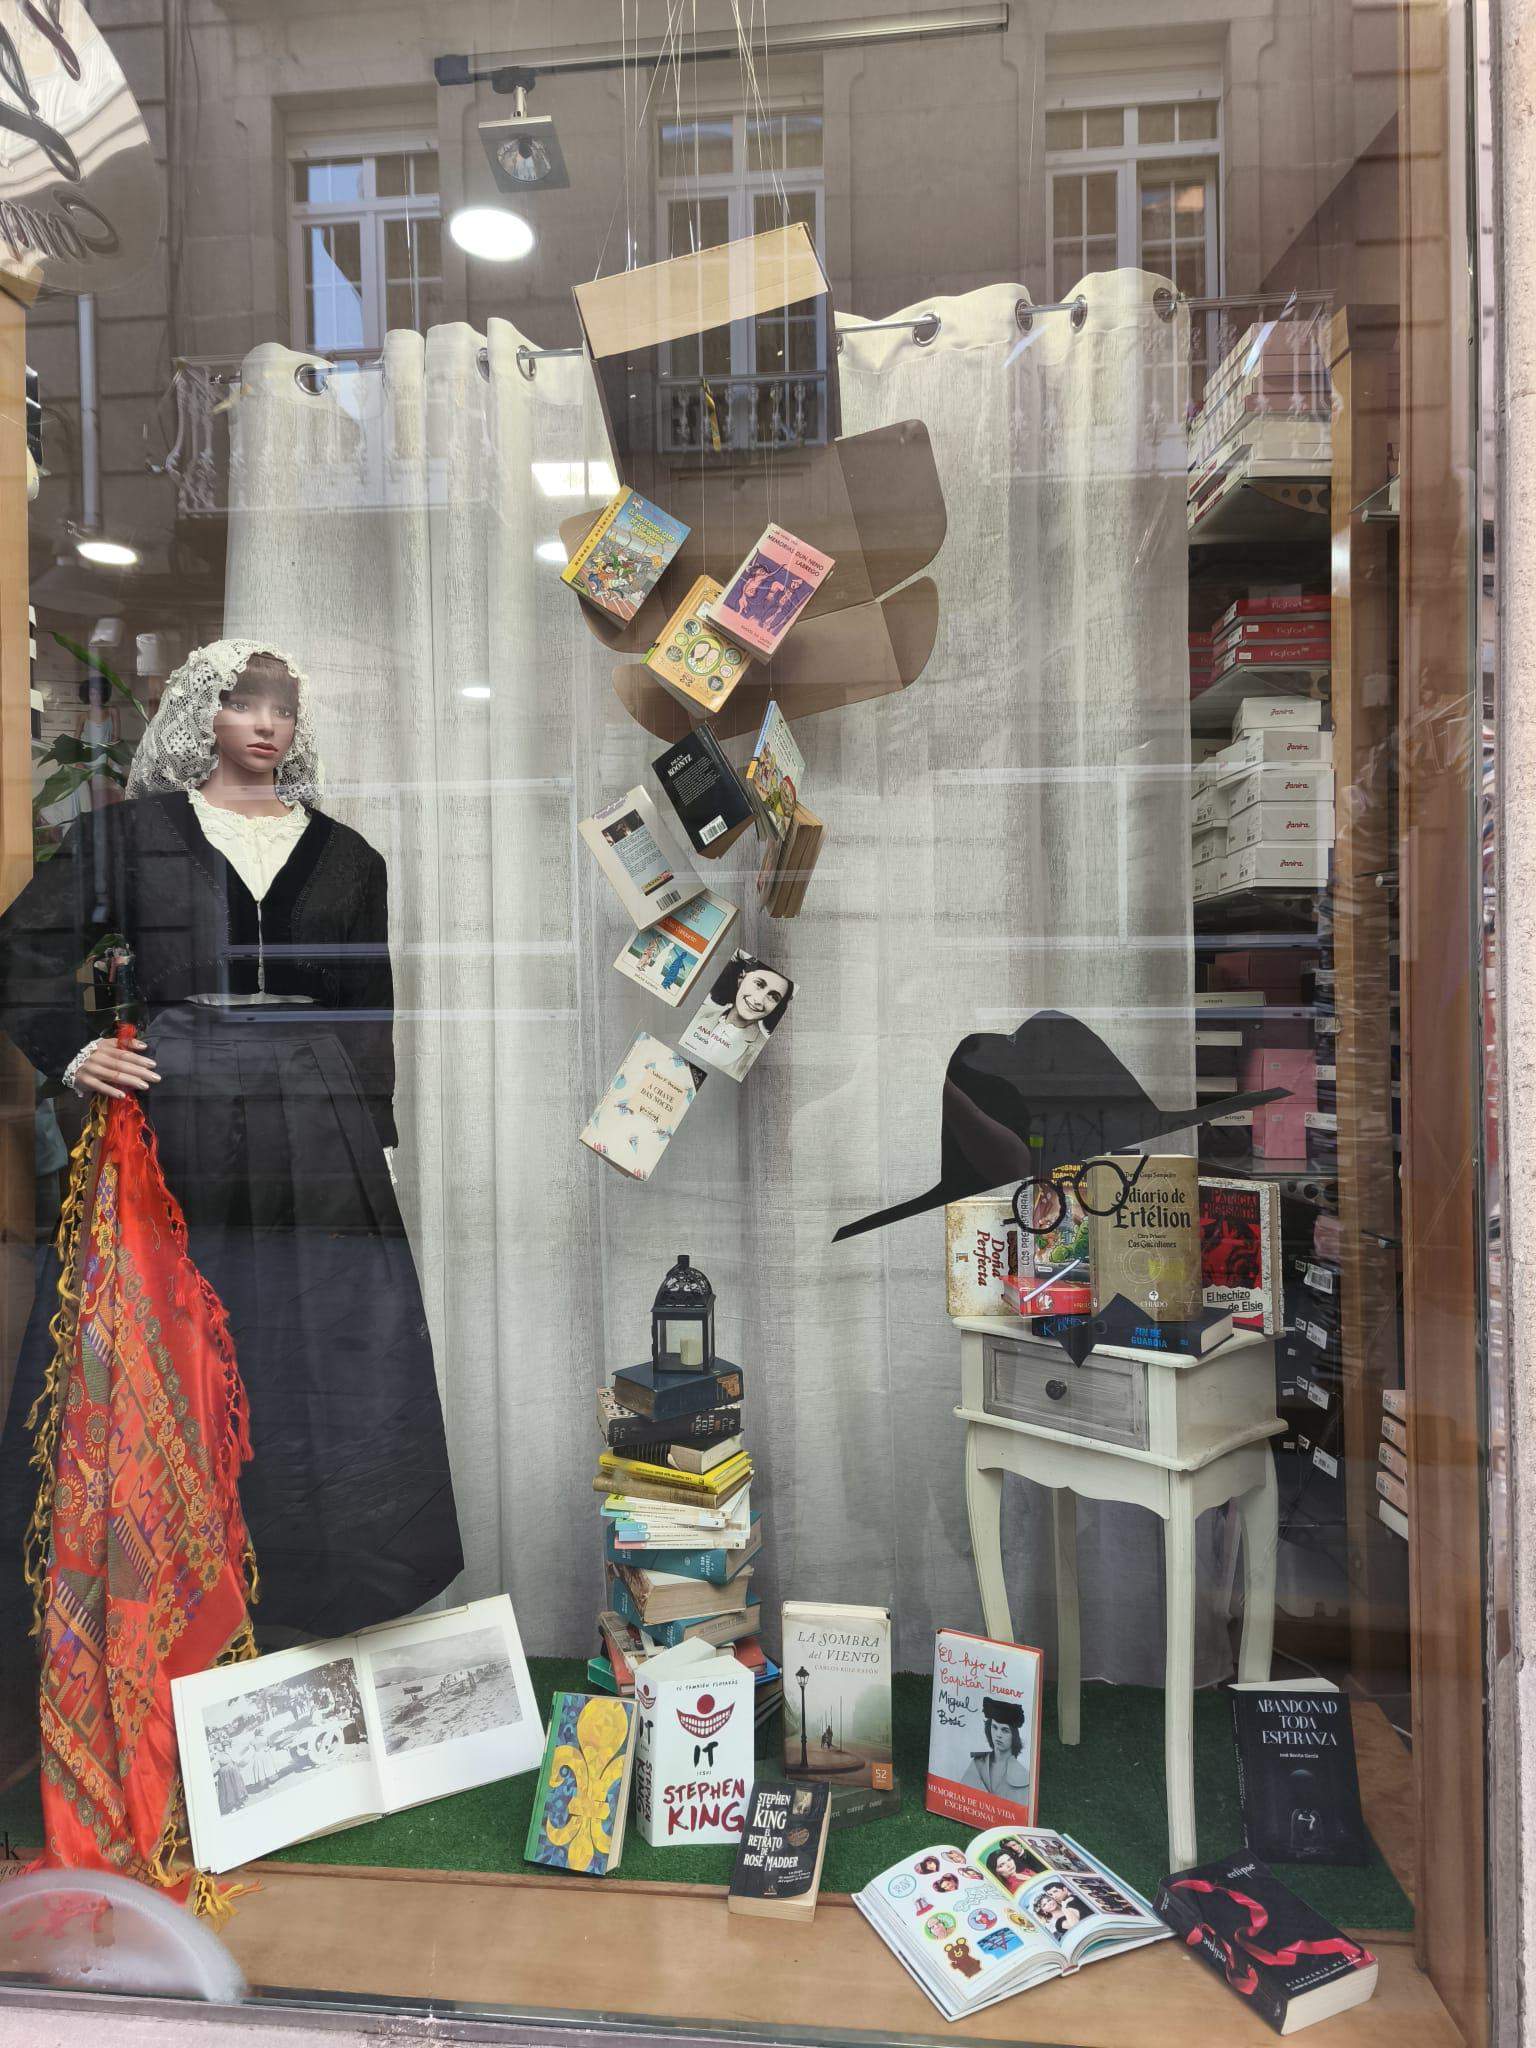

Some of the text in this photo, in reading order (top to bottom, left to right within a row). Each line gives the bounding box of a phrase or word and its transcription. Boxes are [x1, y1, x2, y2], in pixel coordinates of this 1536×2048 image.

[667, 753, 693, 777] KOONTZ
[696, 1024, 712, 1037] ANA
[710, 1031, 731, 1050] FRANK
[1129, 1188, 1169, 1204] diario
[1171, 1188, 1186, 1204] de
[1113, 1203, 1192, 1229] Ertélion
[976, 1229, 991, 1288] Perfecta
[991, 1238, 1006, 1279] Doña
[1206, 1289, 1251, 1301] El hechizo
[1227, 1301, 1263, 1312] de Elsie
[797, 1631, 880, 1648] LA SOMBRA
[808, 1649, 880, 1664] del VIENTO
[938, 1643, 1008, 1678] El hijo del
[940, 1668, 1024, 1699] Capitán Trueno
[938, 1690, 978, 1713] Miguel
[1256, 1699, 1338, 1715] ABANDONAD
[937, 1710, 966, 1728] Bosé
[1279, 1715, 1317, 1730] TODA
[1262, 1730, 1338, 1746] ESPERANZA
[693, 1741, 719, 1768] IT
[874, 1768, 888, 1780] 52
[663, 1778, 745, 1804] STEPHEN
[757, 1791, 791, 1808] STEPHEN
[927, 1784, 1016, 1821] MEMORIAS DE UNA VIDA
[667, 1801, 745, 1836] KING
[752, 1804, 787, 1830] KING
[764, 1829, 771, 1837] EL
[747, 1835, 783, 1852] RETRATO
[760, 1848, 769, 1856] DE
[743, 1853, 799, 1872] ROSE MADDER
[1226, 1863, 1256, 1880] eclipse
[1203, 1938, 1228, 1962] eclipse
